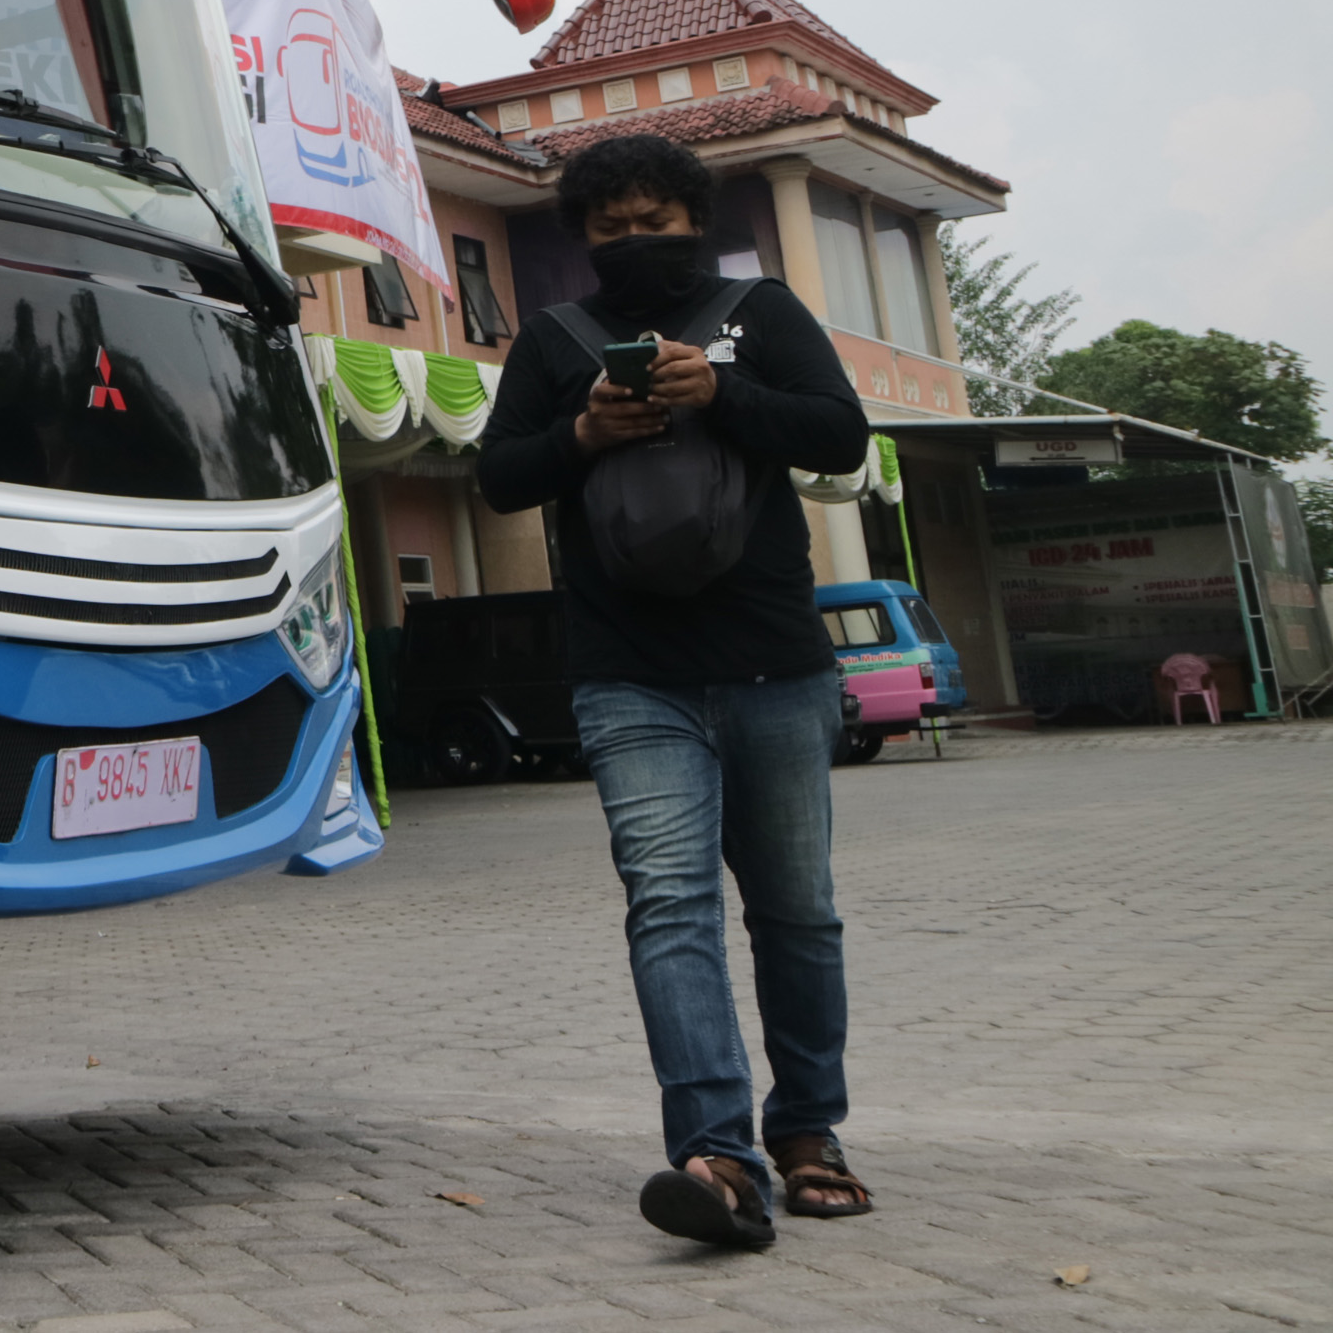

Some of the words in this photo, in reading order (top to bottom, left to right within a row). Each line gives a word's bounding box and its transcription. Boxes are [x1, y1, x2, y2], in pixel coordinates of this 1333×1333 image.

[1036, 441, 1077, 453] UGD
[61, 757, 76, 808] B
[97, 749, 150, 802] 9845
[159, 744, 196, 796] XKZ
